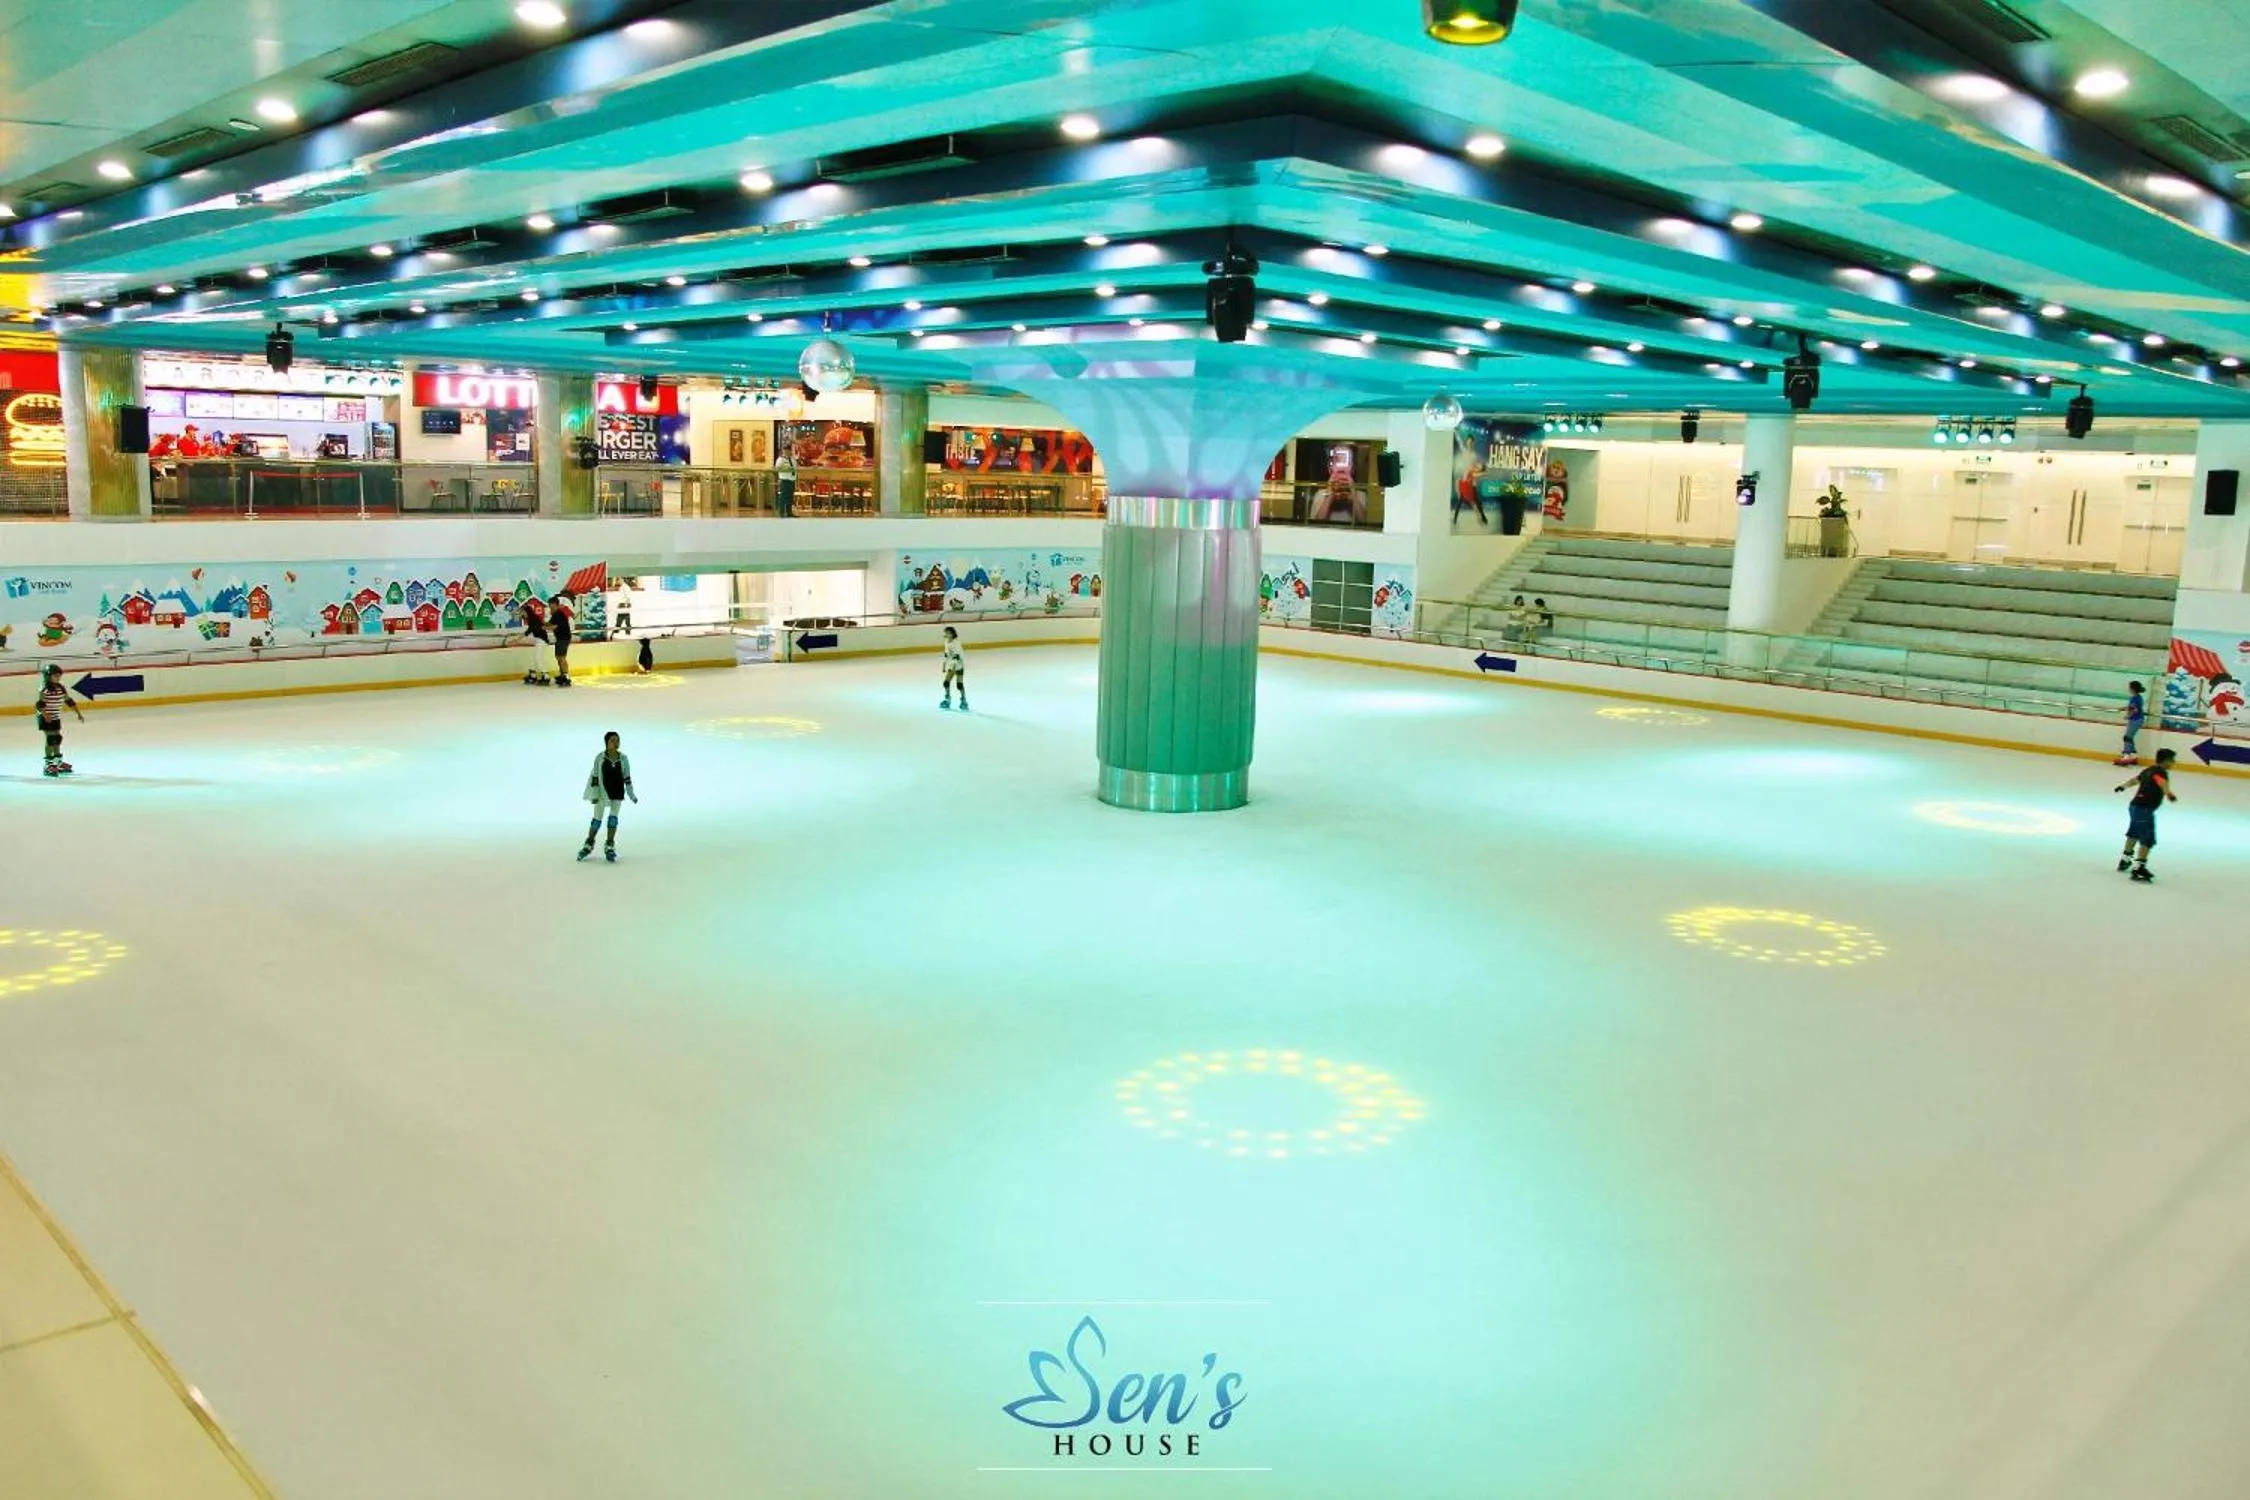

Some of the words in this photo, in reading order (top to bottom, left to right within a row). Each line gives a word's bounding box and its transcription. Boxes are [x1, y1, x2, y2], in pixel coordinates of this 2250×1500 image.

[597, 430, 657, 450] RGER
[611, 451, 637, 460] EVER
[1521, 446, 1544, 471] SAY
[30, 580, 73, 590] VINCOM
